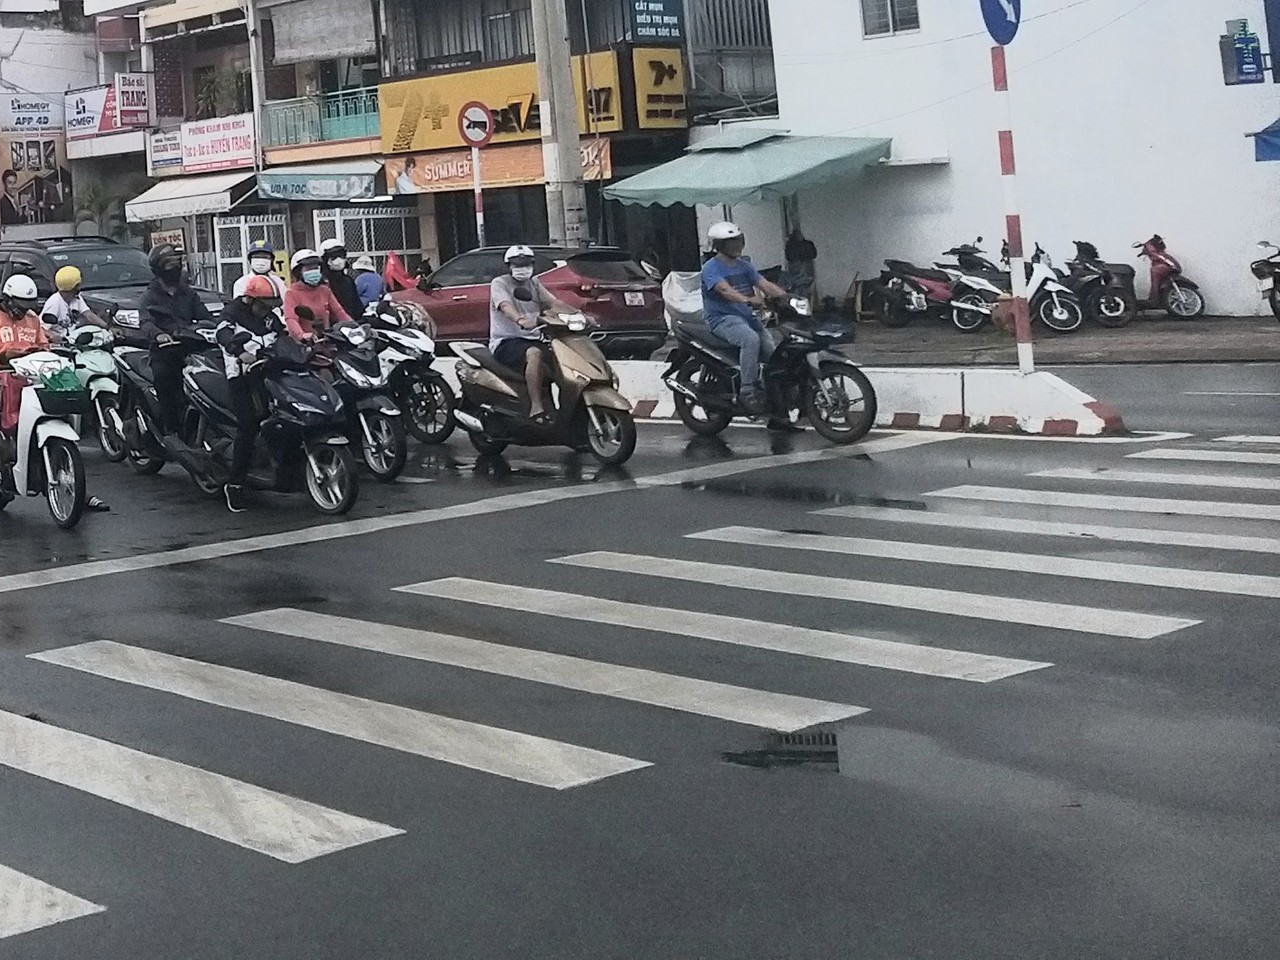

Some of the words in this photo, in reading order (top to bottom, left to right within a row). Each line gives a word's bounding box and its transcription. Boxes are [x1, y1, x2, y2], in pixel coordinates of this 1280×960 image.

[120, 90, 147, 107] TRANG
[36, 116, 50, 125] 4D
[490, 93, 541, 133] SEVE
[424, 159, 471, 181] SUMMER
